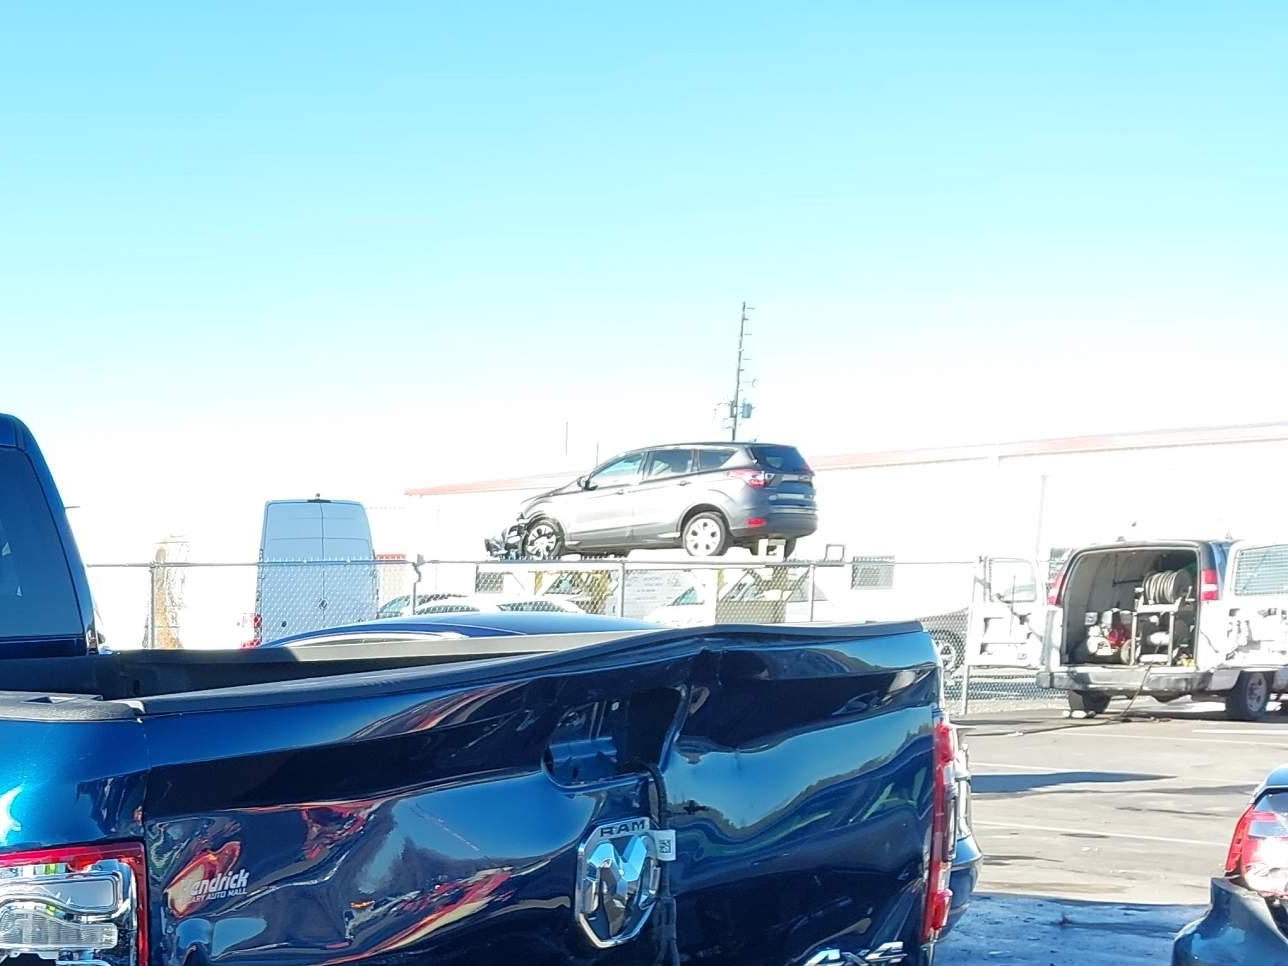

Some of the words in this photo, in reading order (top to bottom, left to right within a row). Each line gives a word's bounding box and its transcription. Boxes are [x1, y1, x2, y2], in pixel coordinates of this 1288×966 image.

[599, 821, 646, 837] RAM
[180, 868, 251, 897] endrick
[206, 890, 227, 901] AUTO
[227, 887, 249, 897] MALL
